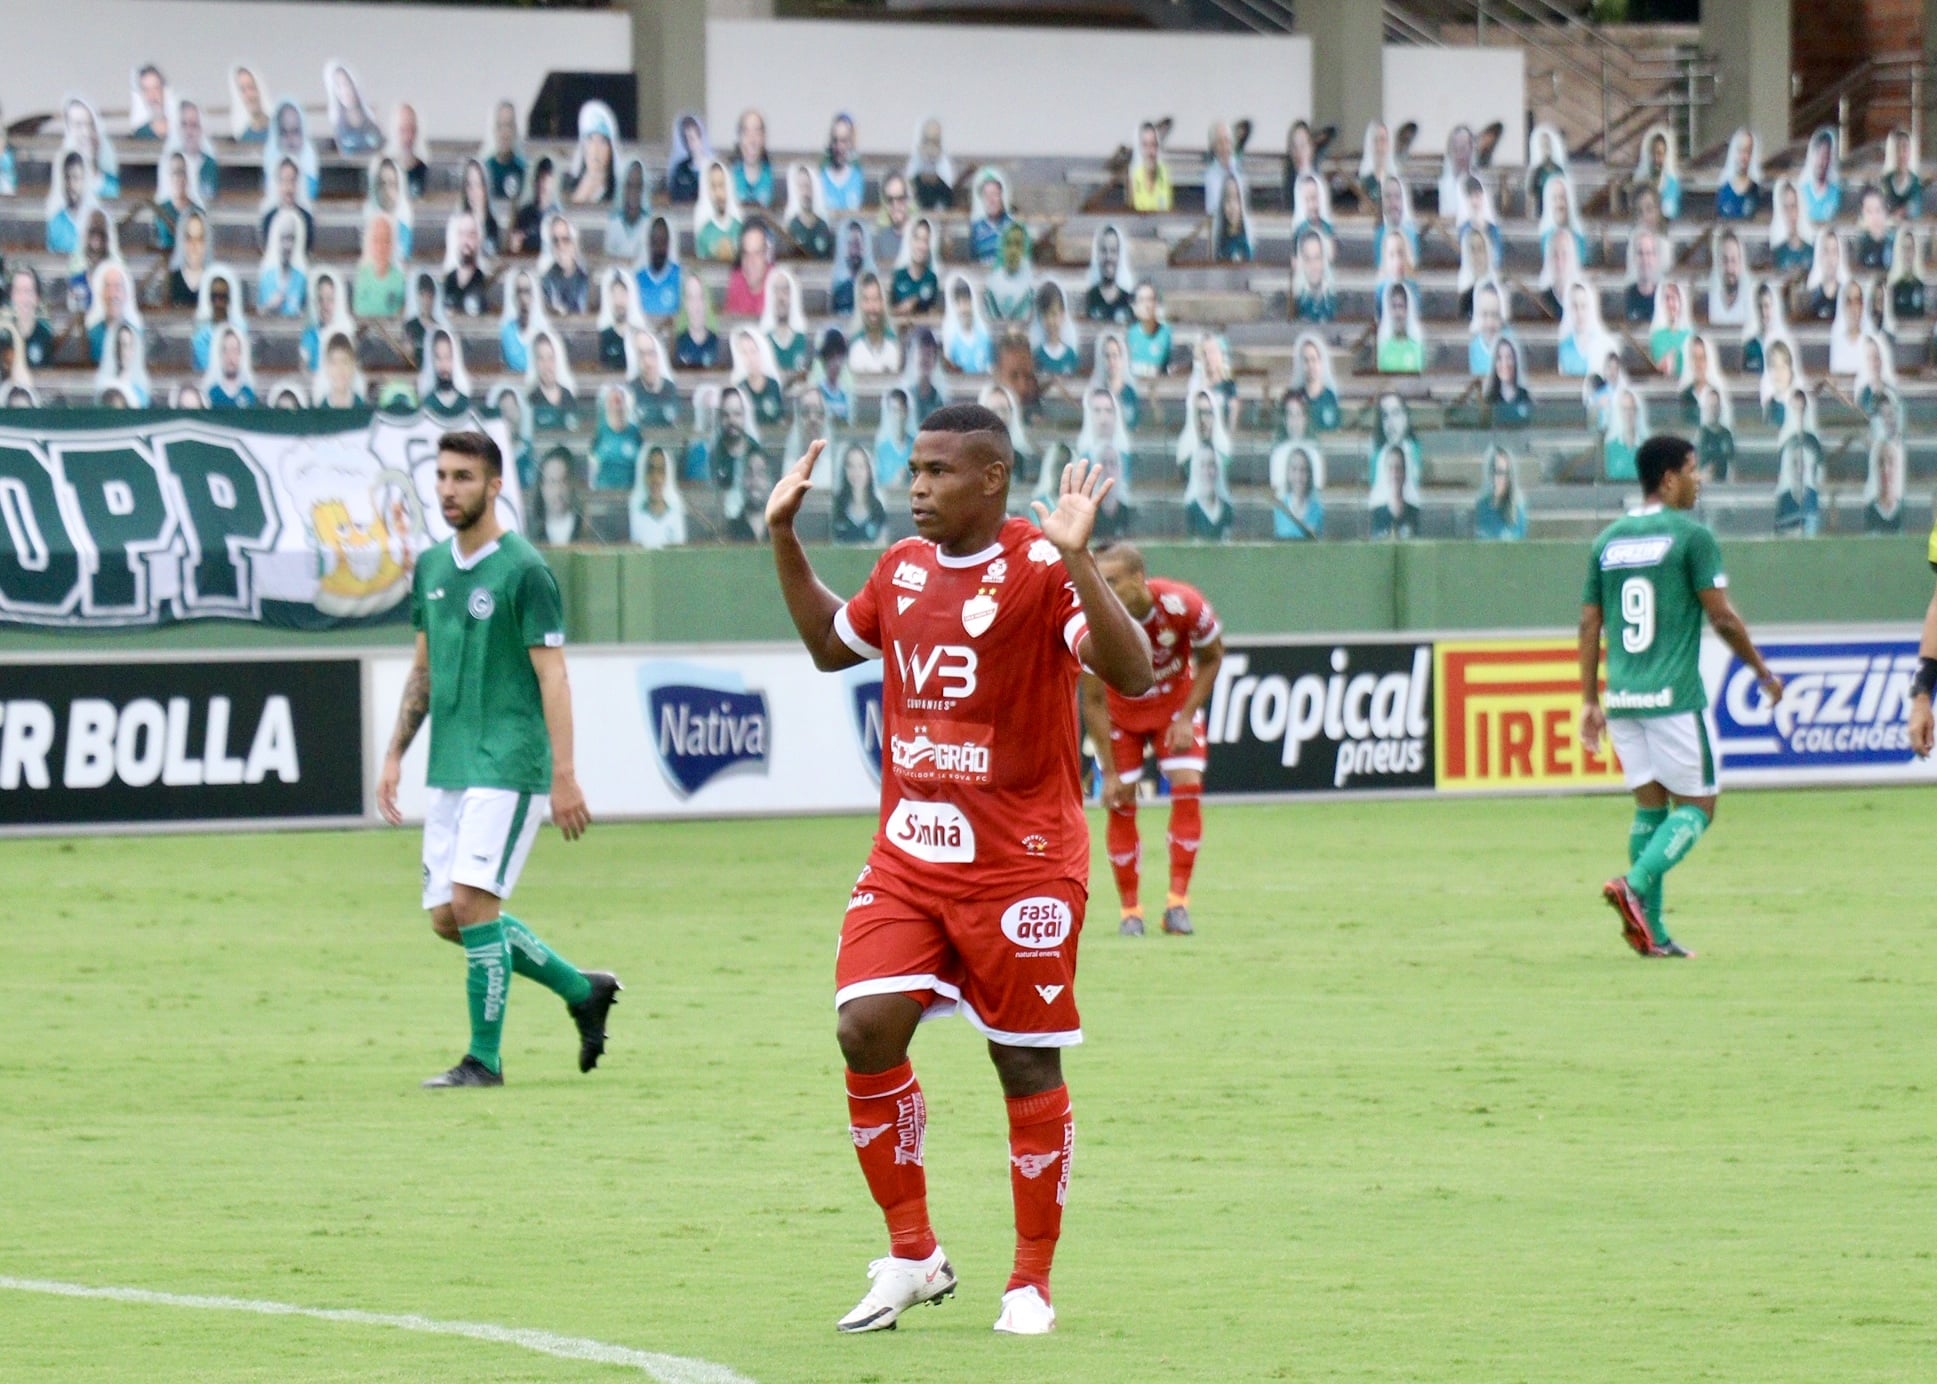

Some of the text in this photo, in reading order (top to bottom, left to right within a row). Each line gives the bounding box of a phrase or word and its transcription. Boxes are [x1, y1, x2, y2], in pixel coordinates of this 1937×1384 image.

[1621, 576, 1656, 654] 9
[0, 694, 300, 790] R BOLLA
[659, 702, 765, 756] Nativa
[1207, 645, 1431, 767] Tropical
[1445, 649, 1624, 779] PIRE
[1333, 738, 1425, 788] pneus
